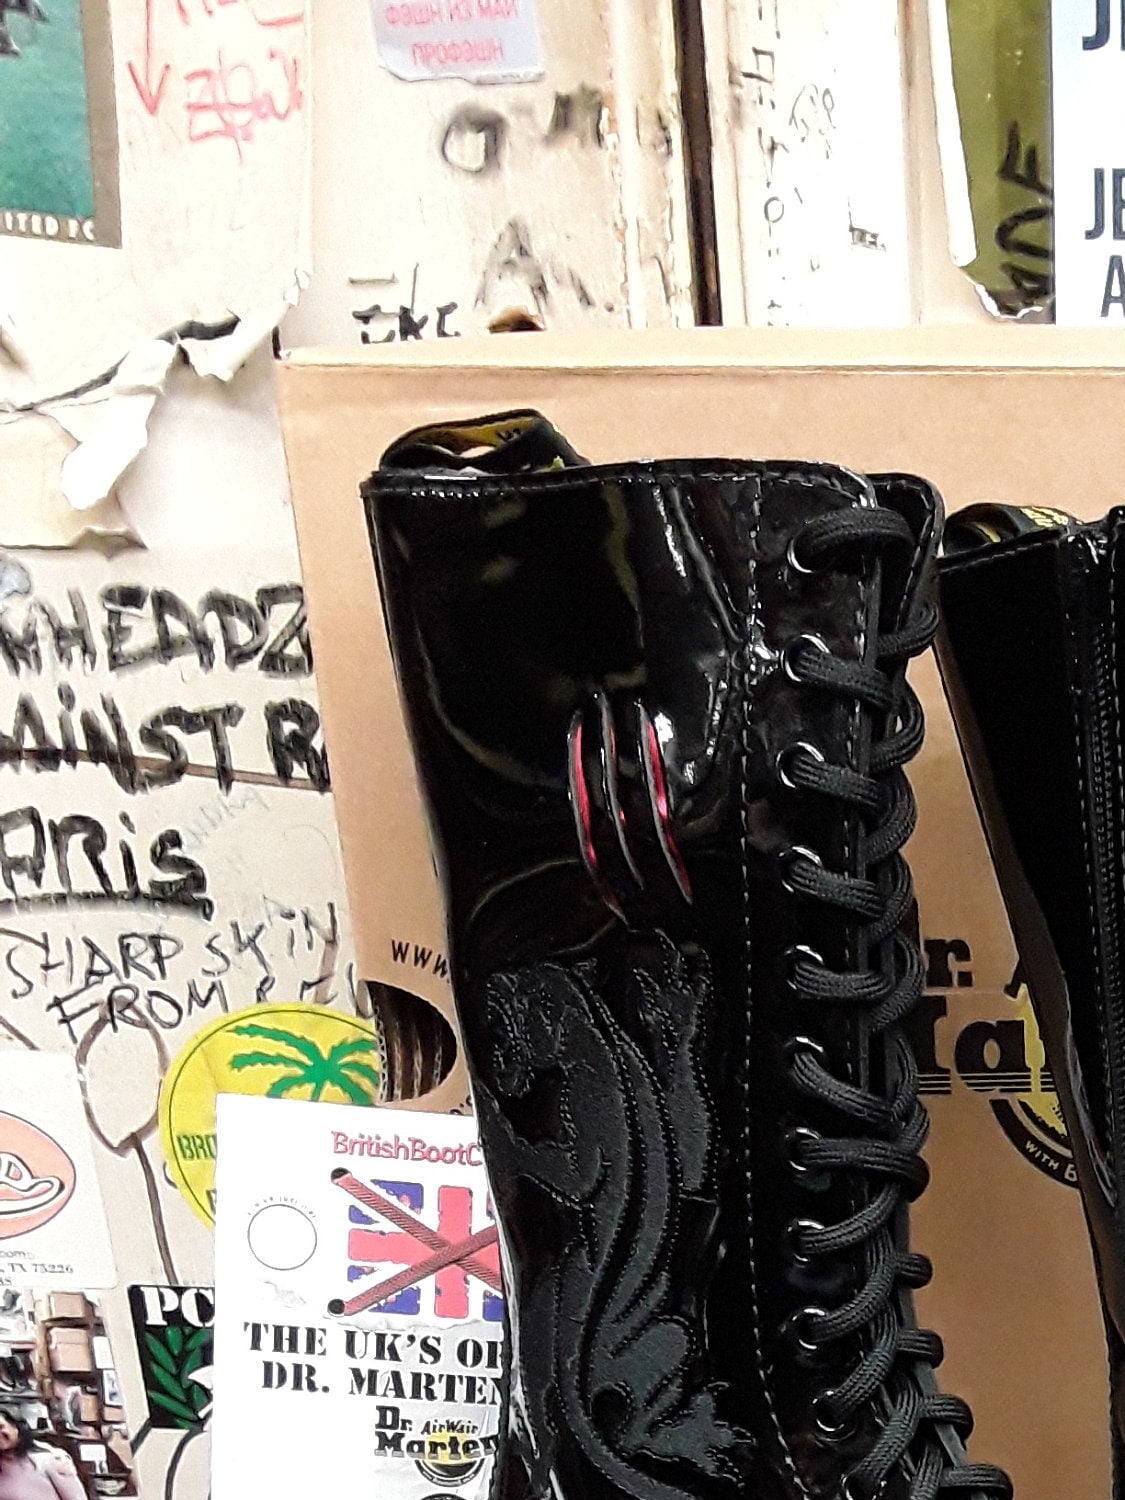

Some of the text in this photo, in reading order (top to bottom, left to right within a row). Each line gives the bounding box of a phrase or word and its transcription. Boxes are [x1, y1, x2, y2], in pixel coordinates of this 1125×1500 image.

[5, 931, 184, 999] SHARP
[45, 978, 230, 1045] FROM
[1024, 1140, 1060, 1170] WITH
[243, 1321, 328, 1357] THE
[343, 1328, 442, 1365] UK'S
[261, 1360, 331, 1394] DR.
